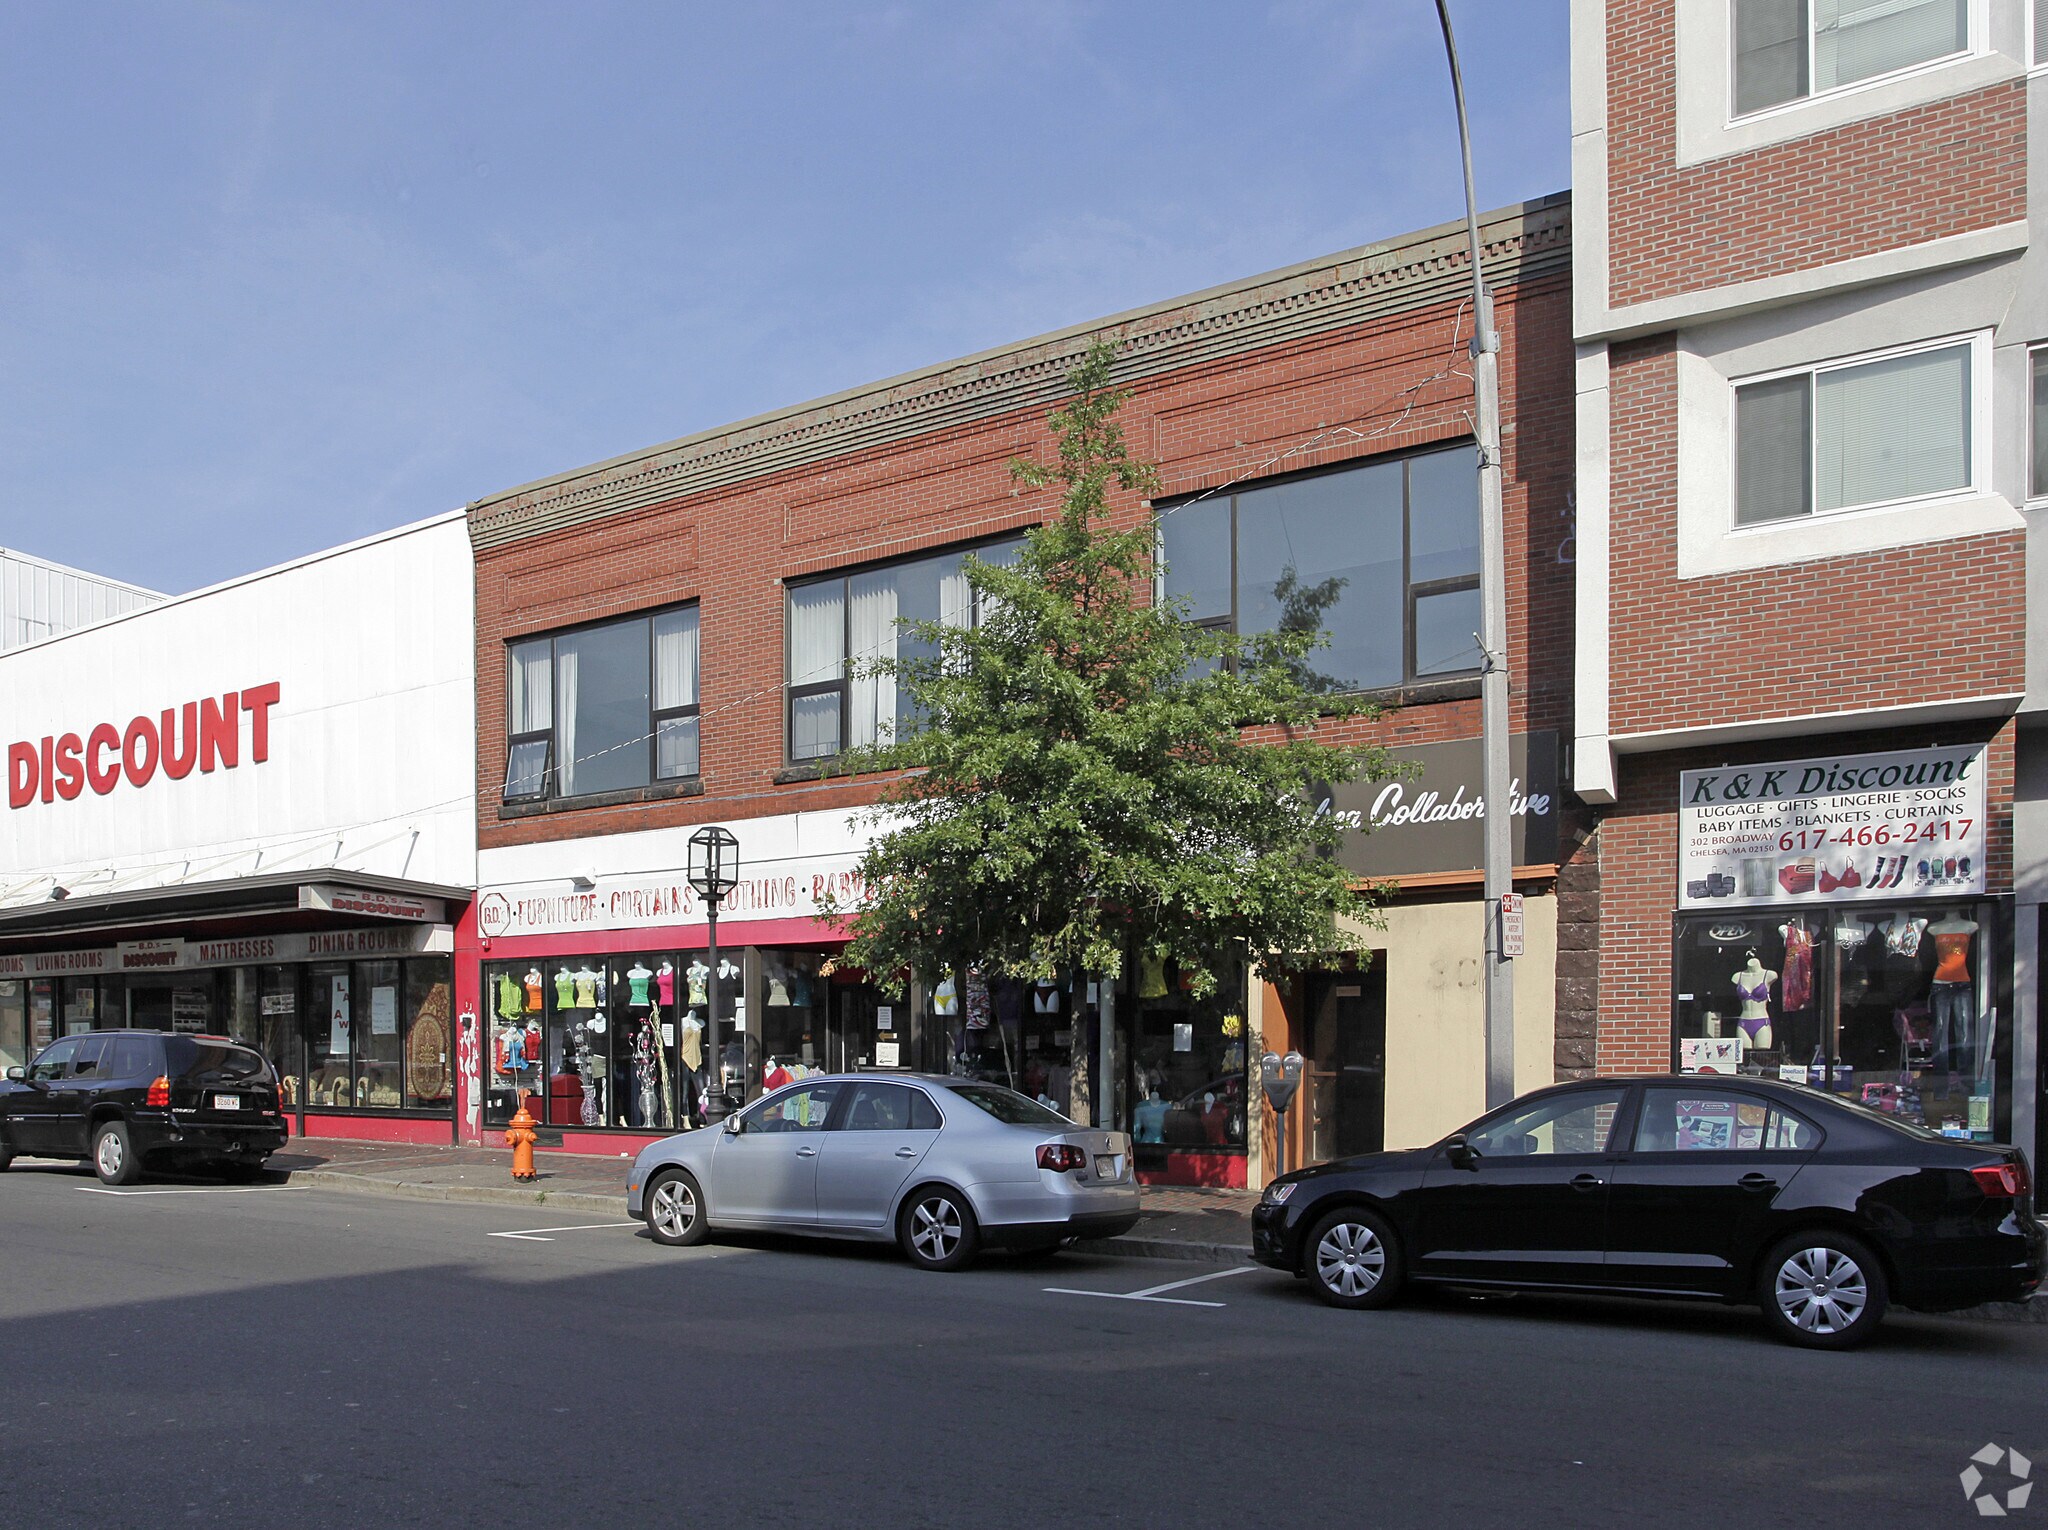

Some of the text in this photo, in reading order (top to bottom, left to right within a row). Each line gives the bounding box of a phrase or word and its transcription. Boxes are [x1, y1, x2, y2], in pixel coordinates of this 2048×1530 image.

[8, 681, 280, 809] DISCOUNT
[1689, 755, 1976, 804] K & K Discount
[1370, 778, 1550, 828] Collabortive
[1697, 787, 1966, 818] LUGGAGE GIFTS LINGERIE SOCKS
[1699, 803, 1964, 833] BABY ITEMS BLANKETS CURTAINS
[1690, 833, 1775, 847] 302 BROADWAY
[1778, 818, 1974, 852] 617-466-2417
[1689, 844, 1775, 858] CHELSEA, MA 02150
[331, 897, 425, 918] DISCOUNT
[610, 886, 694, 919] CURTAINS
[713, 876, 797, 912] LOTHING
[200, 939, 275, 961] MATTRESSES
[309, 932, 354, 954] DINING
[35, 956, 66, 971] LIVING
[69, 952, 103, 969] ROOMS
[123, 951, 178, 968] DISCOUNT
